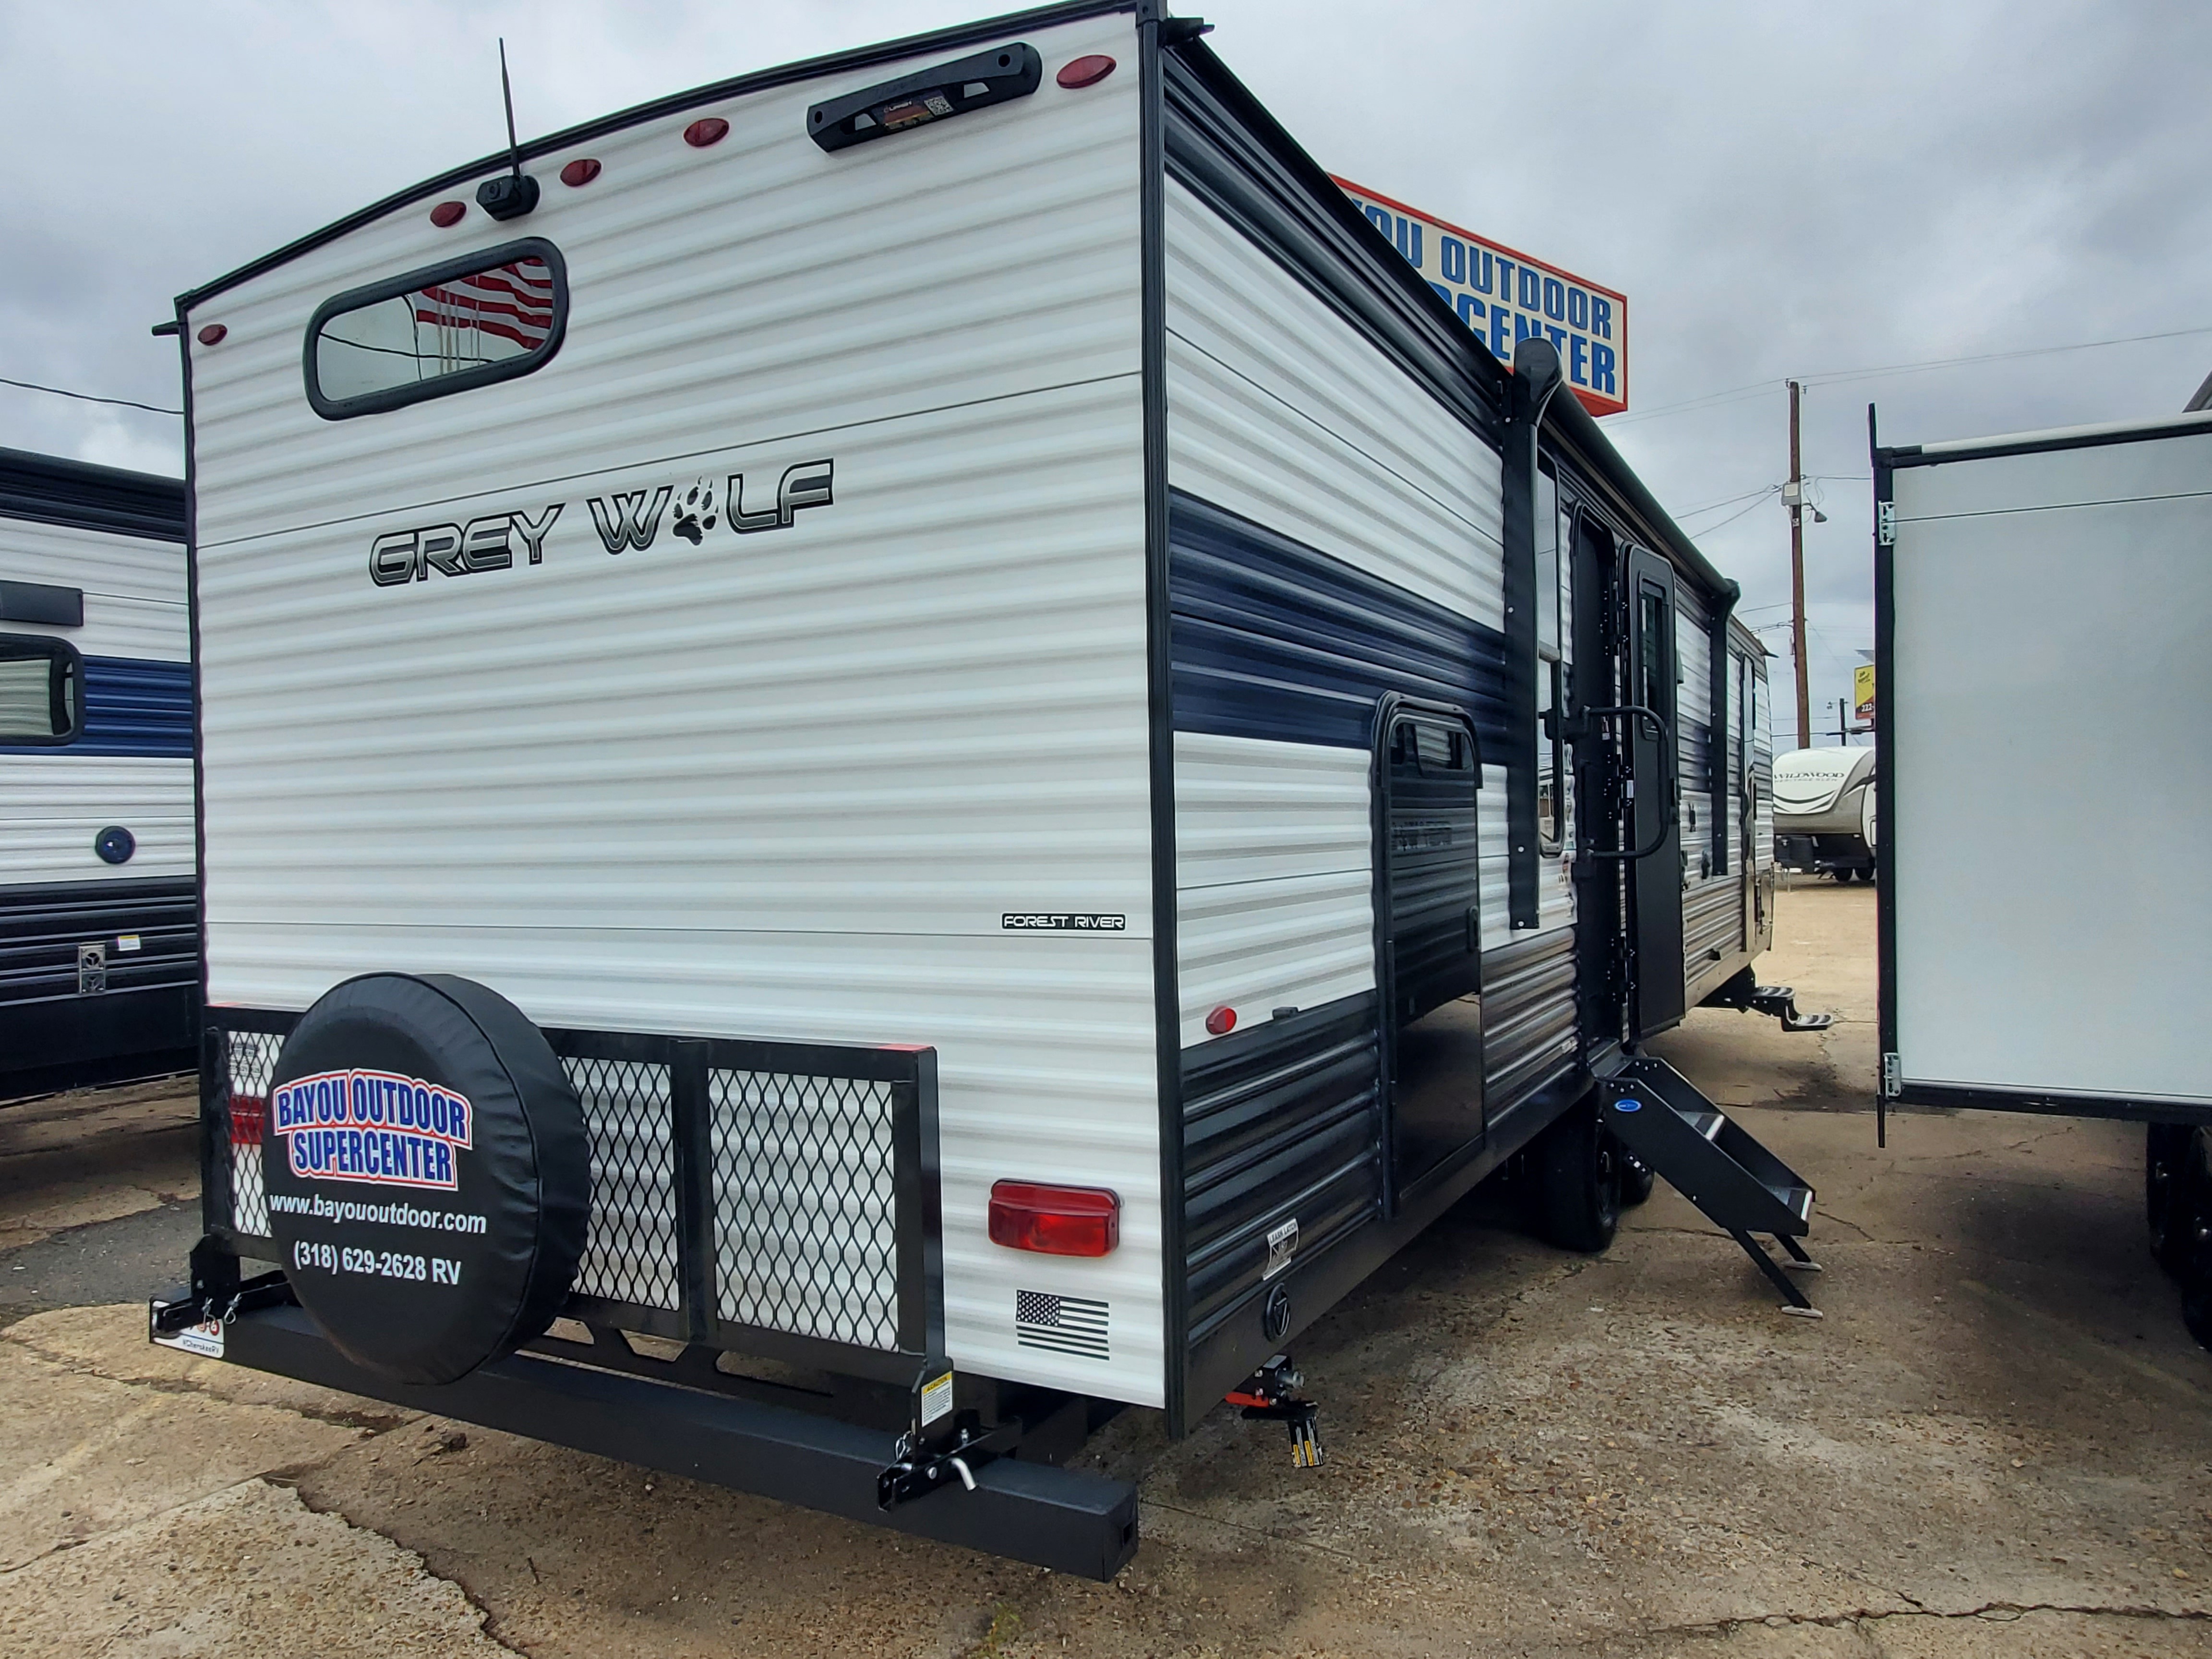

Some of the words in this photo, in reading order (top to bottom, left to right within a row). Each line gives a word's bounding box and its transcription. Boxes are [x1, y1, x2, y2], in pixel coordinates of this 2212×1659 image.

[1351, 197, 1422, 269] OU
[1441, 235, 1611, 340] OUTDOOR
[369, 502, 566, 587] GREY
[1004, 915, 1069, 927] FOREST
[1075, 916, 1124, 928] RIVER
[277, 1077, 347, 1127] BAYOU
[352, 1077, 466, 1140] OUTDOOR
[293, 1130, 452, 1182] SUPERCENTER
[269, 1193, 487, 1234] www.bayououtdoor.com
[294, 1240, 338, 1275] (318)
[342, 1247, 426, 1281] 629-2628
[432, 1258, 461, 1285] RV
